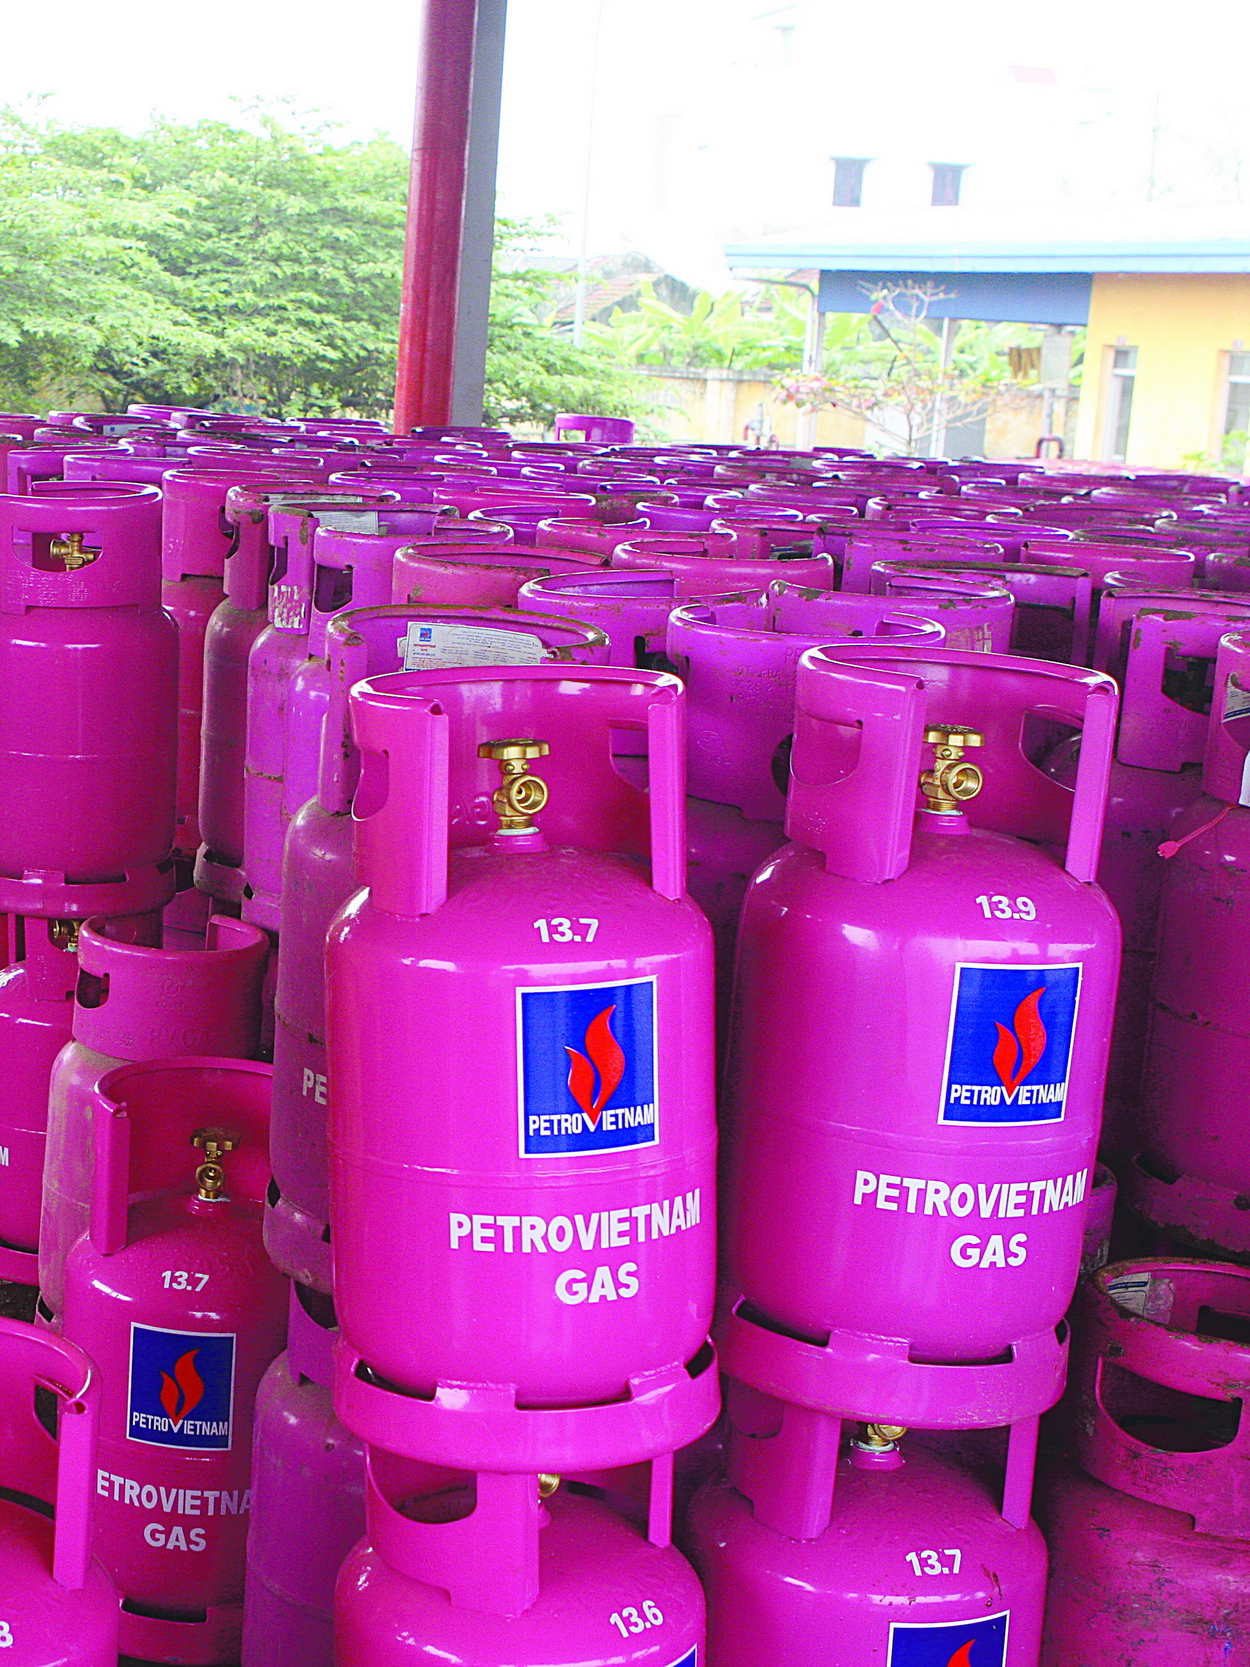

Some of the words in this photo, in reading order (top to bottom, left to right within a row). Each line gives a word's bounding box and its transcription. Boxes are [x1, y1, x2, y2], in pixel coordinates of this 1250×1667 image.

[975, 895, 1037, 921] 13.9
[533, 917, 599, 943] 13.7
[949, 1082, 1066, 1106] PETROVIETNAM
[528, 1102, 655, 1137] PETROVIETNAM
[853, 1167, 1088, 1219] PETROVIETNAM
[448, 1187, 701, 1254] PETROVIETNAM
[949, 1232, 1028, 1269] GAS
[161, 1270, 210, 1292] 13.7
[554, 1261, 640, 1306] GAS
[132, 1411, 229, 1437] PETROVIETNAM
[143, 1522, 208, 1552] GAS
[905, 1548, 962, 1577] 13.7
[609, 1599, 664, 1638] 13.6
